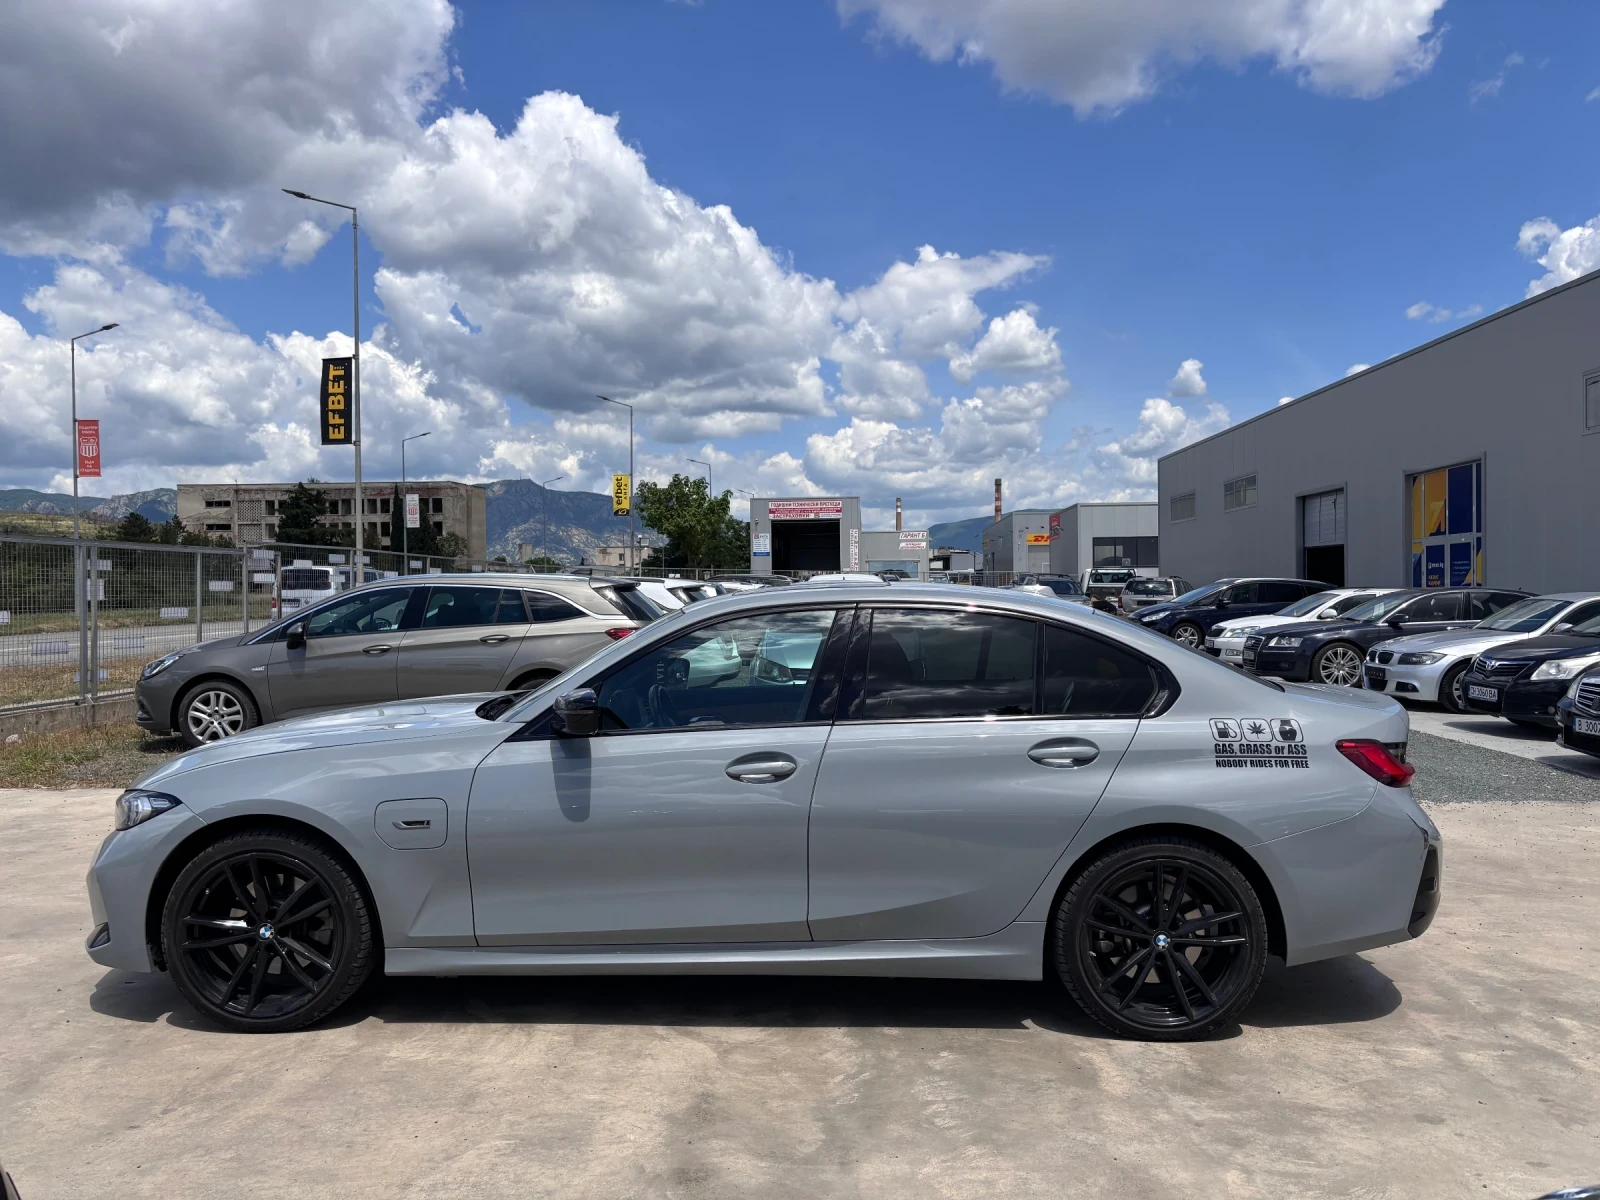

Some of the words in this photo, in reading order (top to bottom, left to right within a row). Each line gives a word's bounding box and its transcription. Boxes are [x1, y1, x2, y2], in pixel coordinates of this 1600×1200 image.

[328, 364, 345, 440] EFBET
[615, 476, 623, 506] efbet
[1214, 743, 1238, 756] GAS,
[1238, 743, 1273, 755] GRASS
[1274, 745, 1286, 755] or
[1287, 744, 1308, 755] ASS
[1215, 759, 1248, 768] NOBODY
[1249, 759, 1274, 768] RIDES
[1274, 759, 1290, 768] FOR
[1290, 760, 1310, 769] FREE
